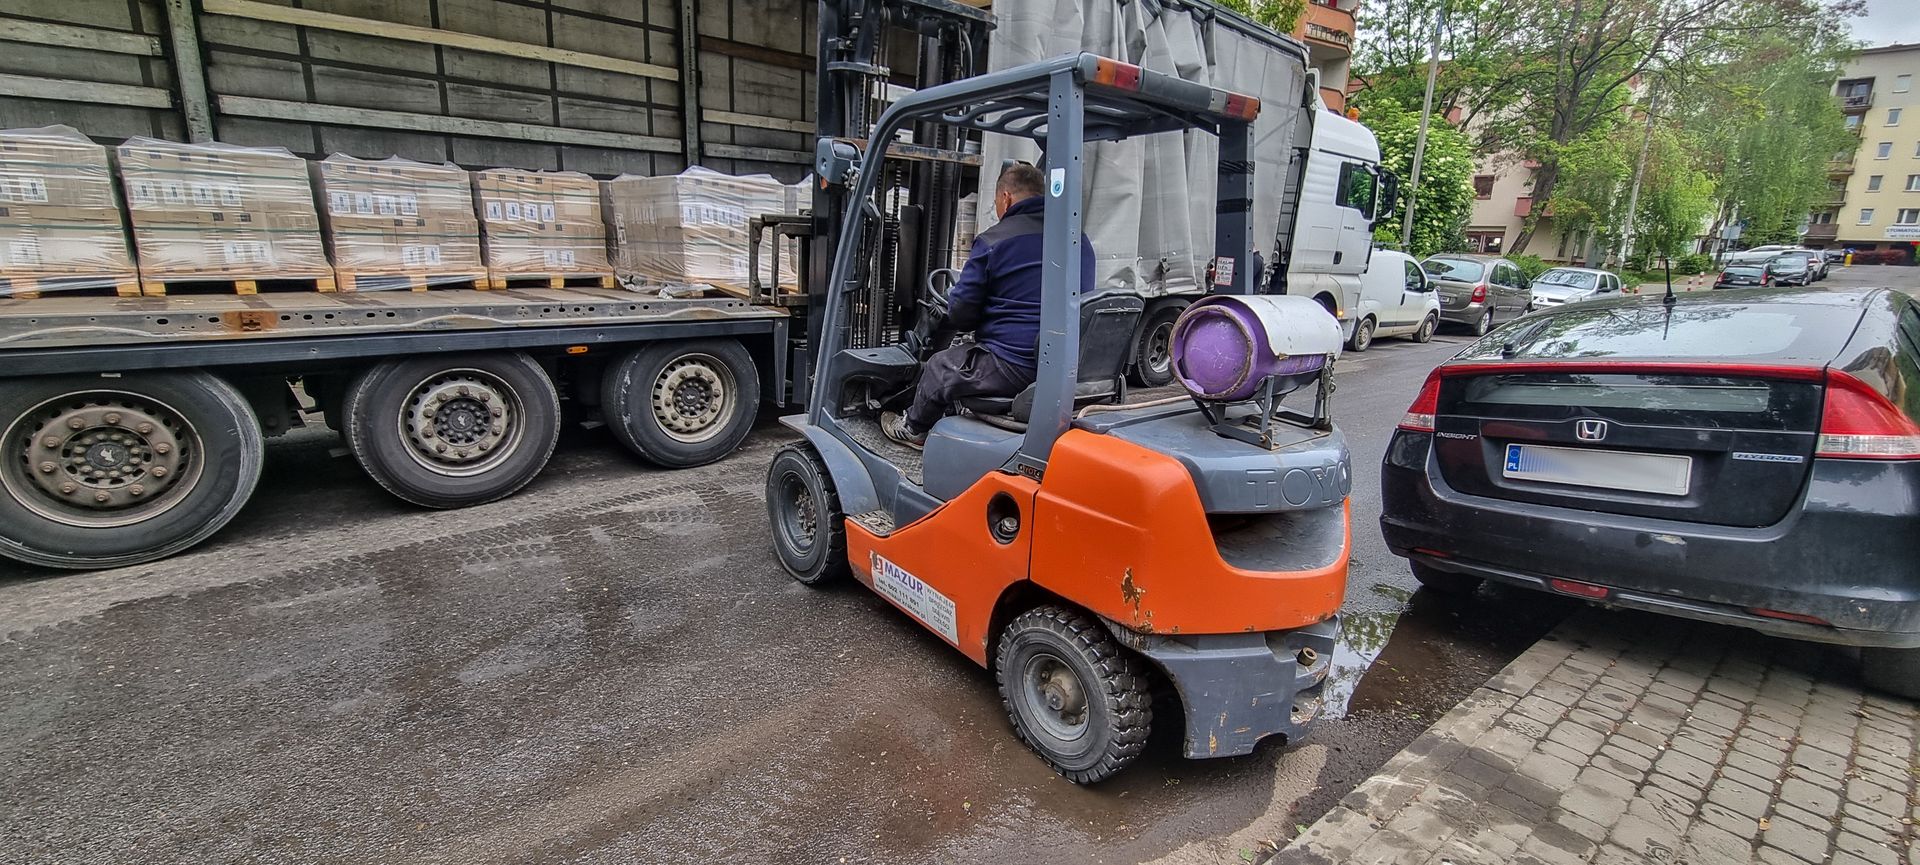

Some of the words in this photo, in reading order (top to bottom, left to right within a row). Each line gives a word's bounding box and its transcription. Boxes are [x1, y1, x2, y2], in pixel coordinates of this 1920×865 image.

[1436, 431, 1478, 440] INSIGHT
[1736, 453, 1799, 462] HYBRID
[1508, 462, 1518, 470] PL
[884, 561, 924, 596] MAZUR
